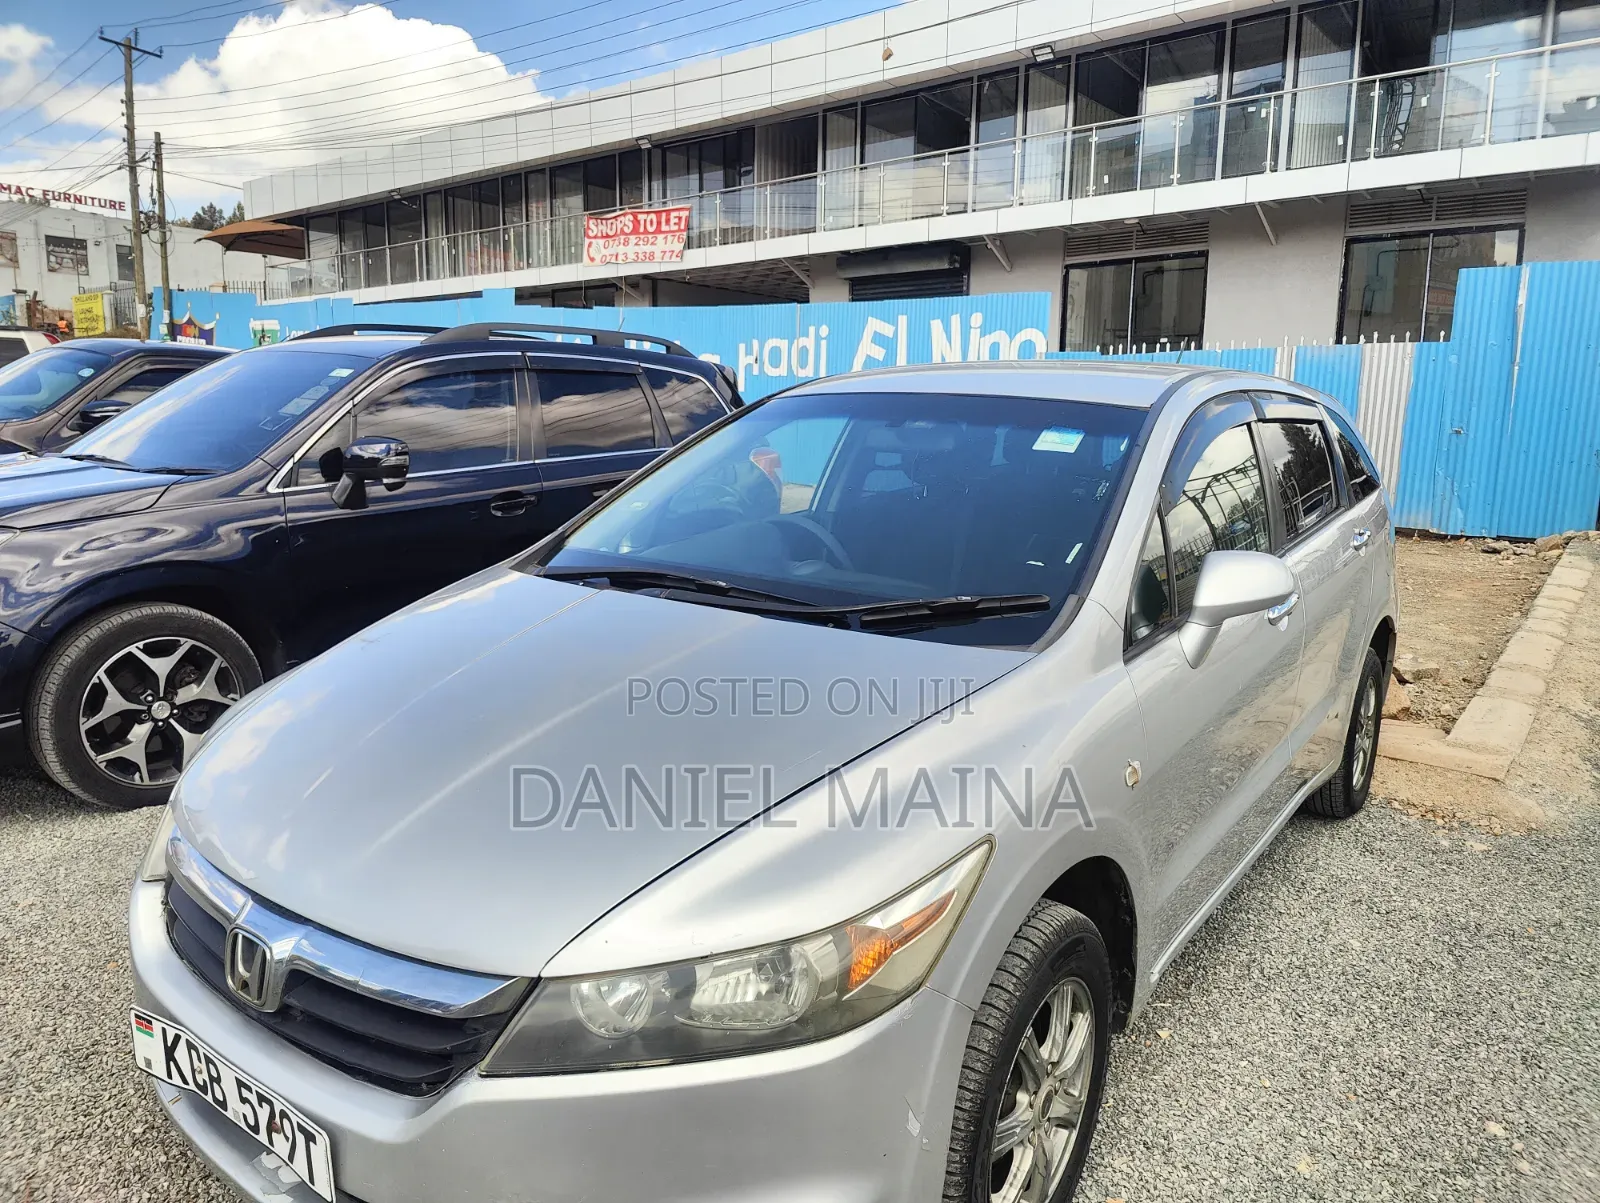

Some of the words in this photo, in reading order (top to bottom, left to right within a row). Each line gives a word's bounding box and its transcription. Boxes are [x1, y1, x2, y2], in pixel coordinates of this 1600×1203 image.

[42, 189, 126, 211] FURNITURE
[587, 213, 634, 237] SHOPS
[636, 212, 658, 233] TO
[661, 210, 690, 232] LET
[634, 235, 658, 246] 292
[663, 233, 685, 245] 176
[600, 251, 628, 264] 0713
[632, 251, 655, 262] 338
[660, 249, 683, 261] 774
[161, 1026, 228, 1113] KCB
[234, 1075, 317, 1187] 579T
